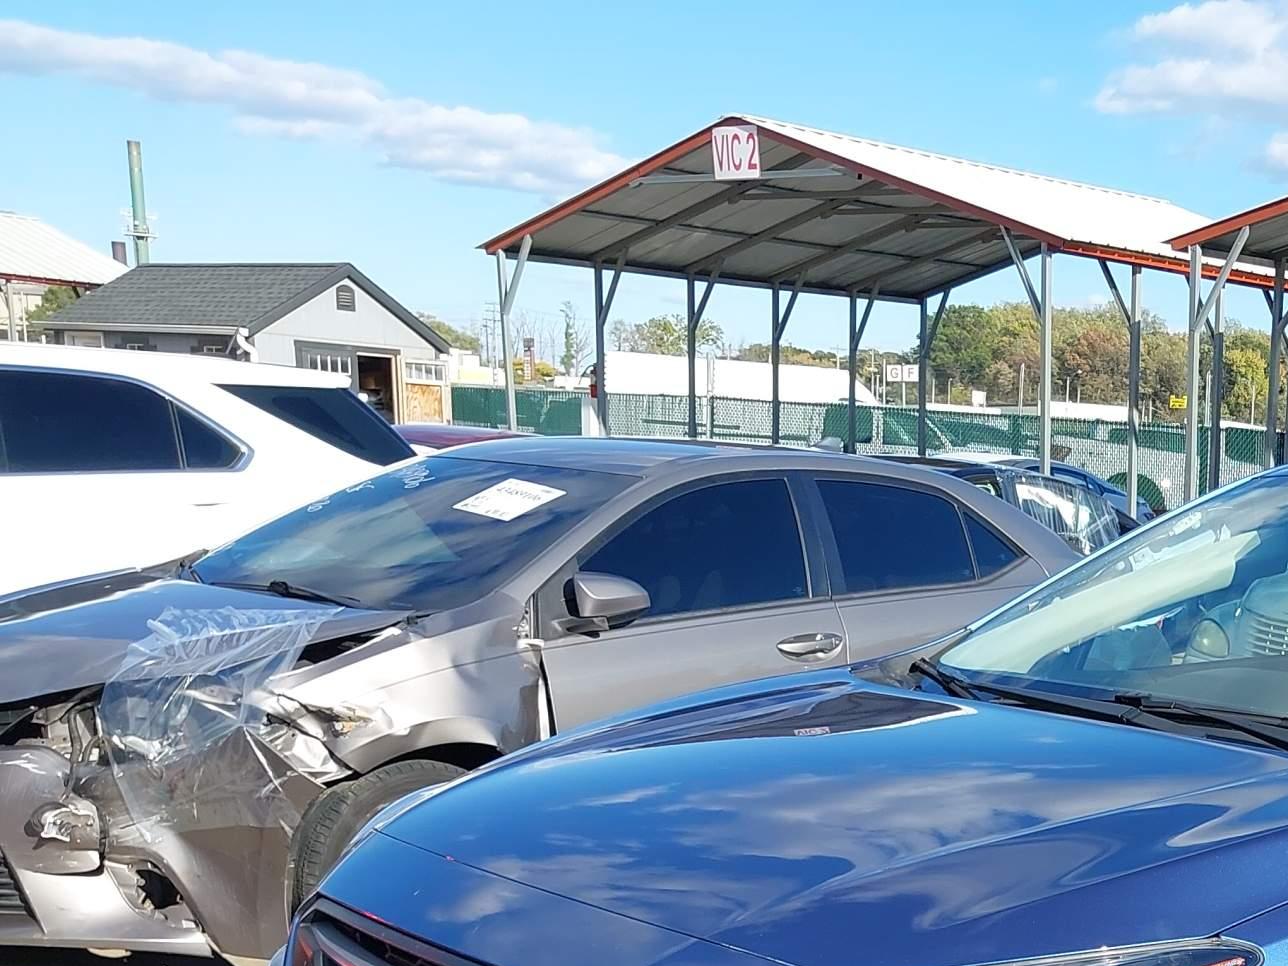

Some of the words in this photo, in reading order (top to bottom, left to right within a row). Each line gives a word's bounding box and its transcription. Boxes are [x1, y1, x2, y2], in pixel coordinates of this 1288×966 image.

[714, 133, 743, 172] VIC
[746, 132, 758, 170] 2
[890, 367, 899, 379] G
[907, 367, 915, 379] F
